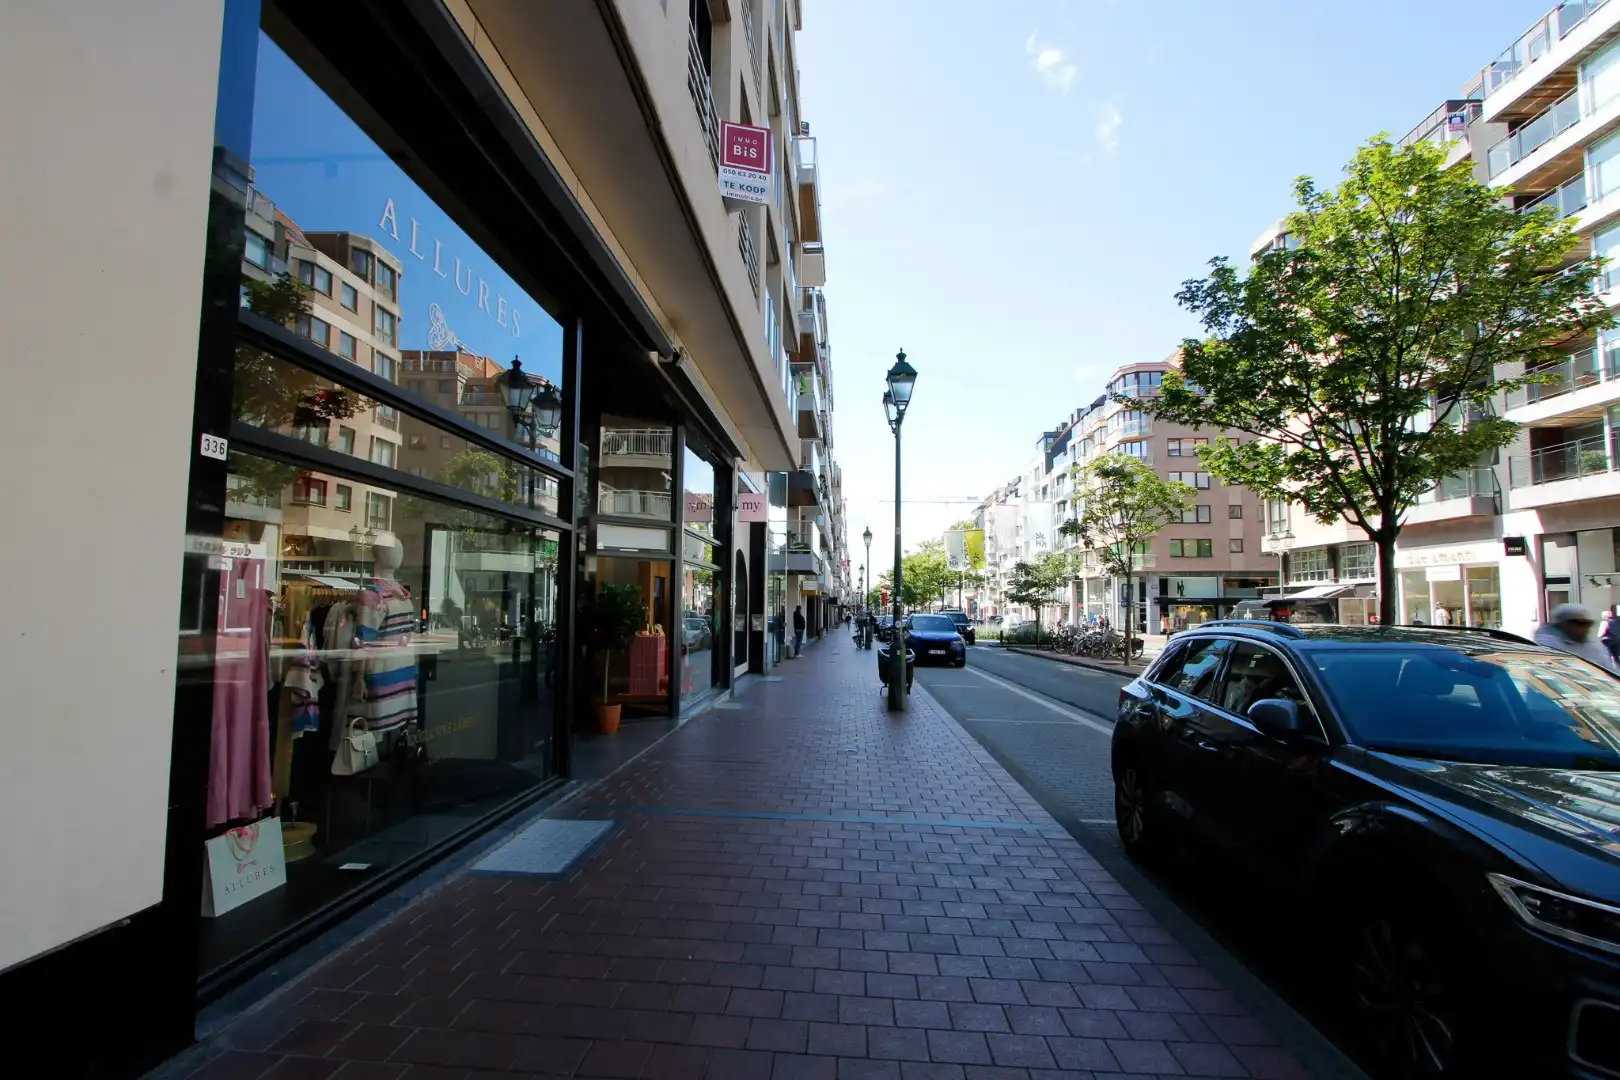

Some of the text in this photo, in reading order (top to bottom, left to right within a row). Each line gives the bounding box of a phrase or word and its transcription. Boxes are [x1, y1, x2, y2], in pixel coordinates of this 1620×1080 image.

[733, 136, 758, 145] IMMO
[733, 145, 758, 159] BiS
[724, 181, 766, 194] TE KOOP
[378, 197, 521, 338] ALLURES
[204, 438, 225, 455] 336
[225, 863, 276, 896] ALLURES
